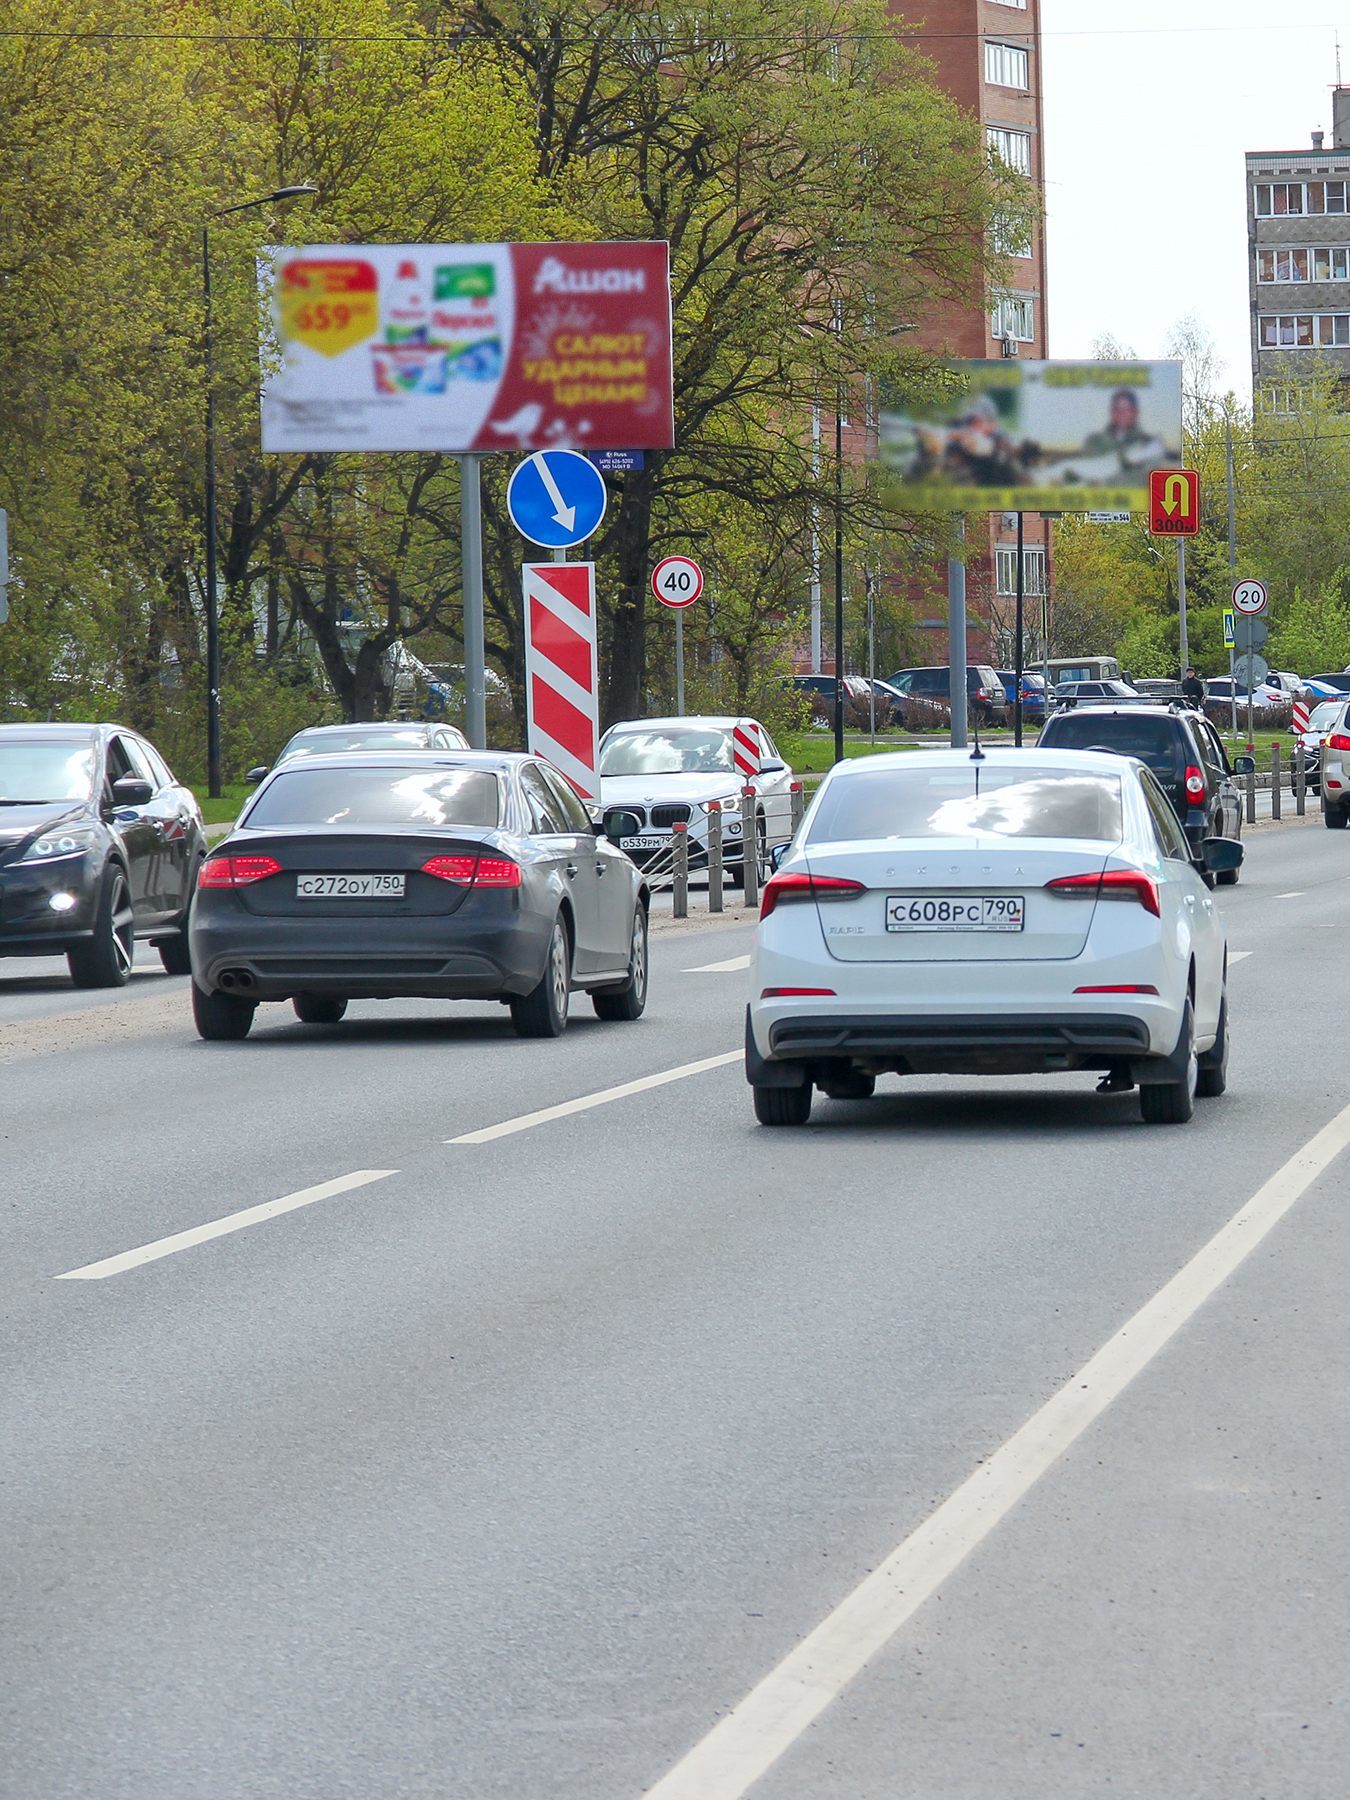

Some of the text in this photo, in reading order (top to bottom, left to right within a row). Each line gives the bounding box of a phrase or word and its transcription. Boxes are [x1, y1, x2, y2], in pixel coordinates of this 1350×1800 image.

[533, 257, 645, 294] Ашан
[664, 572, 691, 591] 40
[1240, 590, 1260, 604] 20
[622, 838, 660, 848] О539РМ
[302, 876, 400, 894] С272ОУ 750
[893, 900, 1017, 922] С608РС 790
